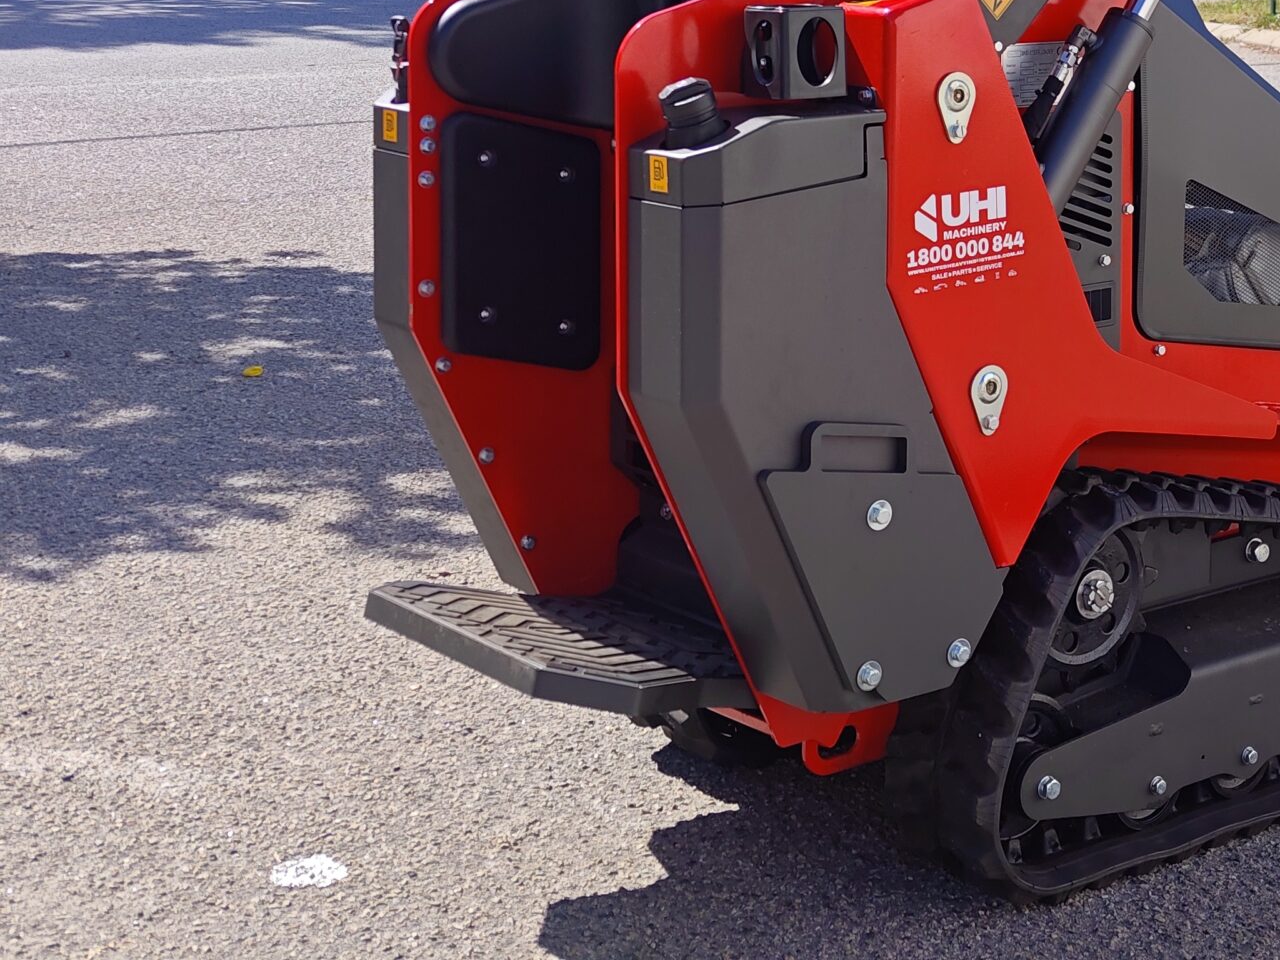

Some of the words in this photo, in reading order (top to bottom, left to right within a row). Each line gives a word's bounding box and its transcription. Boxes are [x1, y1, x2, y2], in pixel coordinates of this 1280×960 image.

[941, 185, 1006, 226] UHI
[943, 221, 1007, 240] MACHINERY
[907, 244, 952, 268] 1800
[956, 237, 989, 258] 000
[992, 231, 1025, 253] 844
[952, 267, 972, 277] PARTS
[976, 262, 1003, 273] SERVICE
